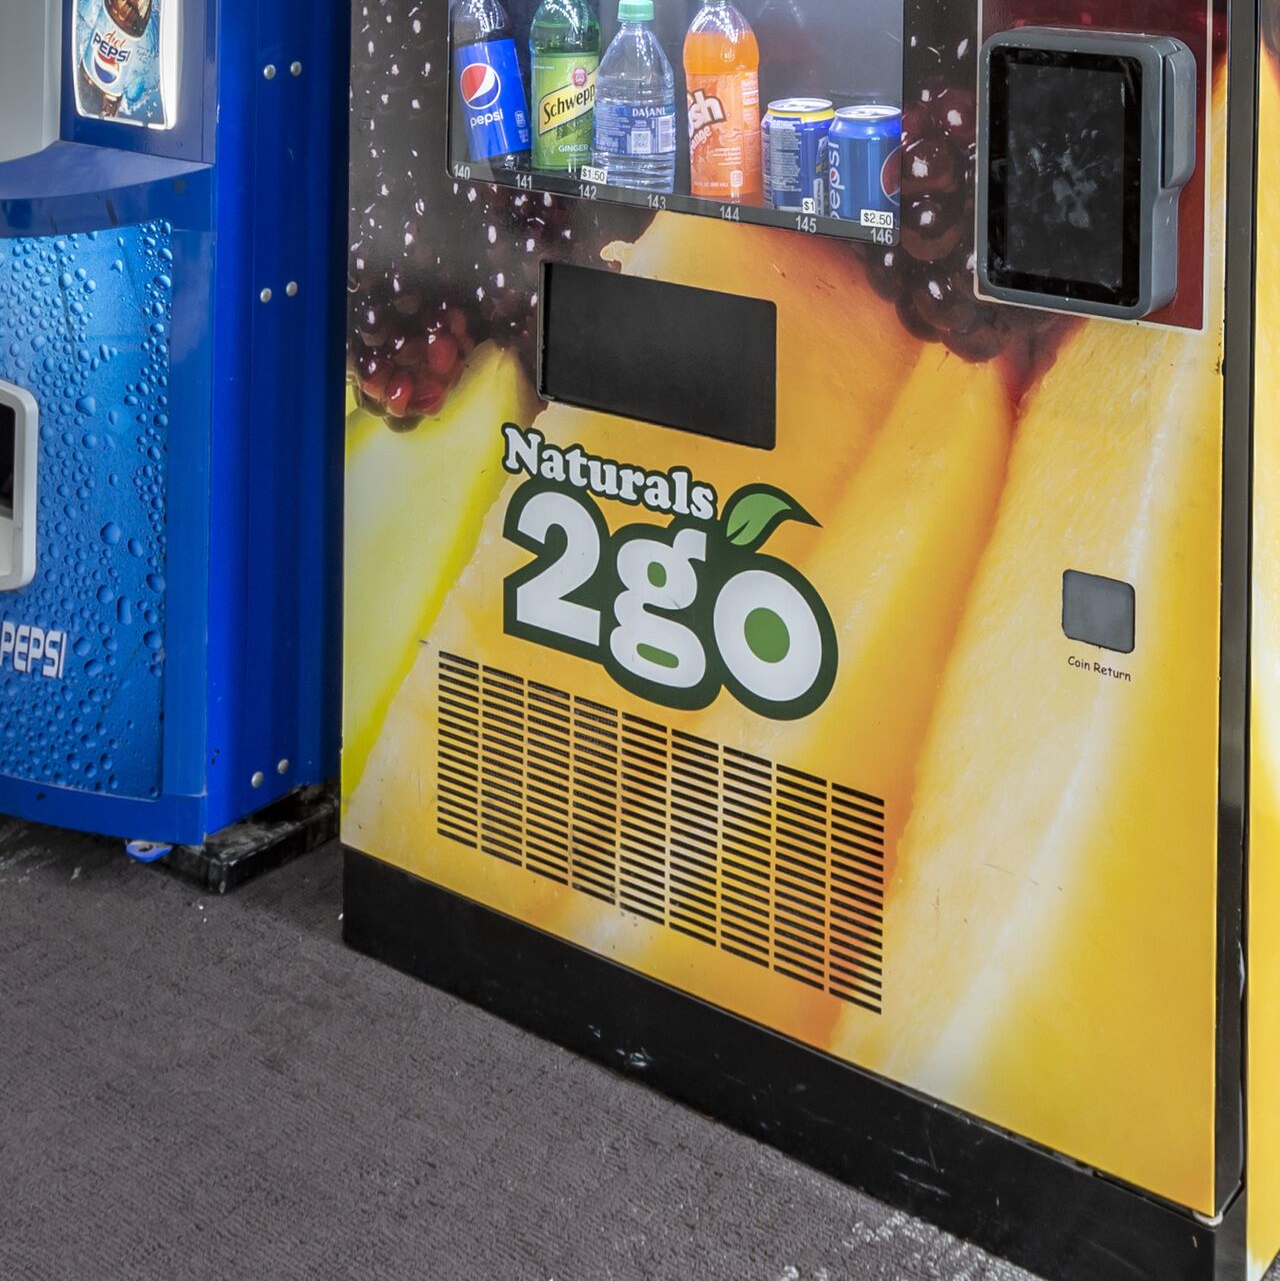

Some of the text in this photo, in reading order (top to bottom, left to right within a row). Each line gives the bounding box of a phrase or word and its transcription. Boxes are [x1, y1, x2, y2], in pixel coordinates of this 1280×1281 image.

[93, 33, 131, 63] PEPSI
[632, 106, 667, 118] DASANI
[687, 89, 726, 132] sh
[470, 108, 504, 130] pepsi
[558, 144, 589, 153] GINGER
[453, 164, 470, 179] 140
[582, 169, 605, 182] $1.50
[515, 174, 532, 190] 141
[579, 184, 597, 200] 142
[647, 194, 667, 209] 143
[803, 201, 815, 212] $1
[720, 205, 740, 222] 144
[863, 212, 892, 226] $2.50
[795, 215, 817, 233] 145
[870, 227, 893, 245] 146
[503, 426, 714, 520] Naturals
[515, 490, 823, 703] 2go
[1067, 655, 1132, 682] Coin Return
